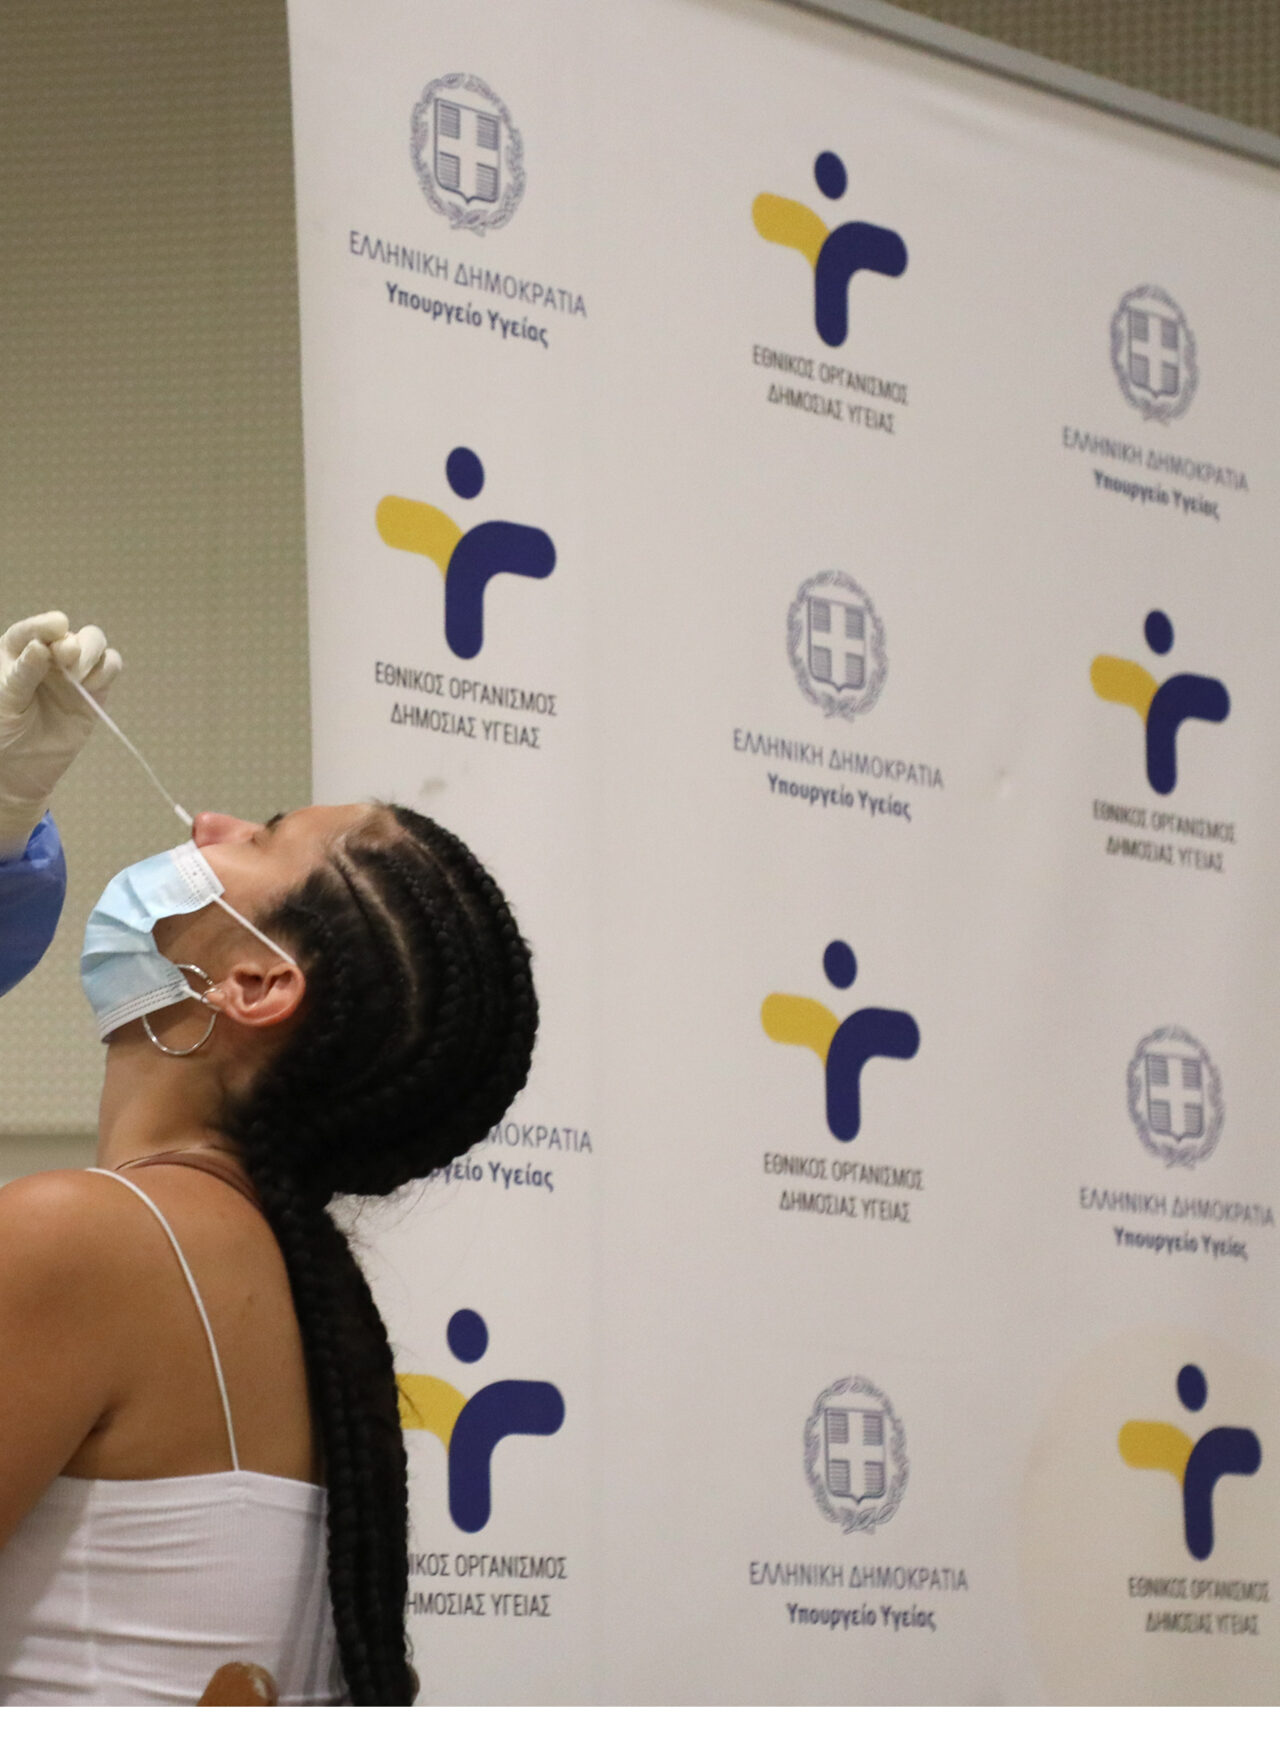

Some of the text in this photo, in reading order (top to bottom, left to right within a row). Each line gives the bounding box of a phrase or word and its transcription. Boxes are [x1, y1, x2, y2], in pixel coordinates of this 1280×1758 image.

[349, 230, 588, 318] ΕΛΛΗΝΙΚΗ ΔΗΜΟΚΡΑΤΙΑ
[386, 281, 550, 349] Υπουργείο Υγείας
[753, 344, 908, 406] ΕΘΝΙΚΟΣ ΟΡΓΑΝΙΣΜΟΣ
[767, 383, 895, 435] ΔΗΜΟΣΙΑΣ ΥΓΕΙΑΣ
[375, 661, 558, 716] ΕΘΝΙΚΟΣ ΟΡΓΑΝΙΣΜΟΣ
[390, 703, 540, 749] ΔΗΜΟΣΙΑΣ ΥΓΕΙΑΣ
[733, 728, 945, 791] ΕΛΛΗΝΙΚΗ ΔΗΜΟΚΡΑΤΙΑ
[767, 772, 912, 823] Υπουργείο Υγείας
[488, 1122, 593, 1153] ΜΟΚΡΑΤΙΑ
[430, 1156, 555, 1193] ργείο Υγείας
[764, 1152, 924, 1191] ΕΘΝΙΚΟΣ ΟΡΓΑΝΙΣΜΟΣ
[779, 1190, 910, 1223] ΔΗΜΟΣΙΑΣ ΥΓΕΙΑΣ
[407, 1553, 568, 1579] ΙΚΟΣ ΟΡΓΑΝΙΣΜΟΣ
[749, 1561, 969, 1591] ΕΛΛΗΝΙΚΗ ΔΗΜΟΚΡΑΤΙΑ
[406, 1592, 551, 1617] ΗΜΟΣΙΑΣ ΥΓΕΙΑΣ
[786, 1602, 937, 1633] Υπουργείο Υγείας
